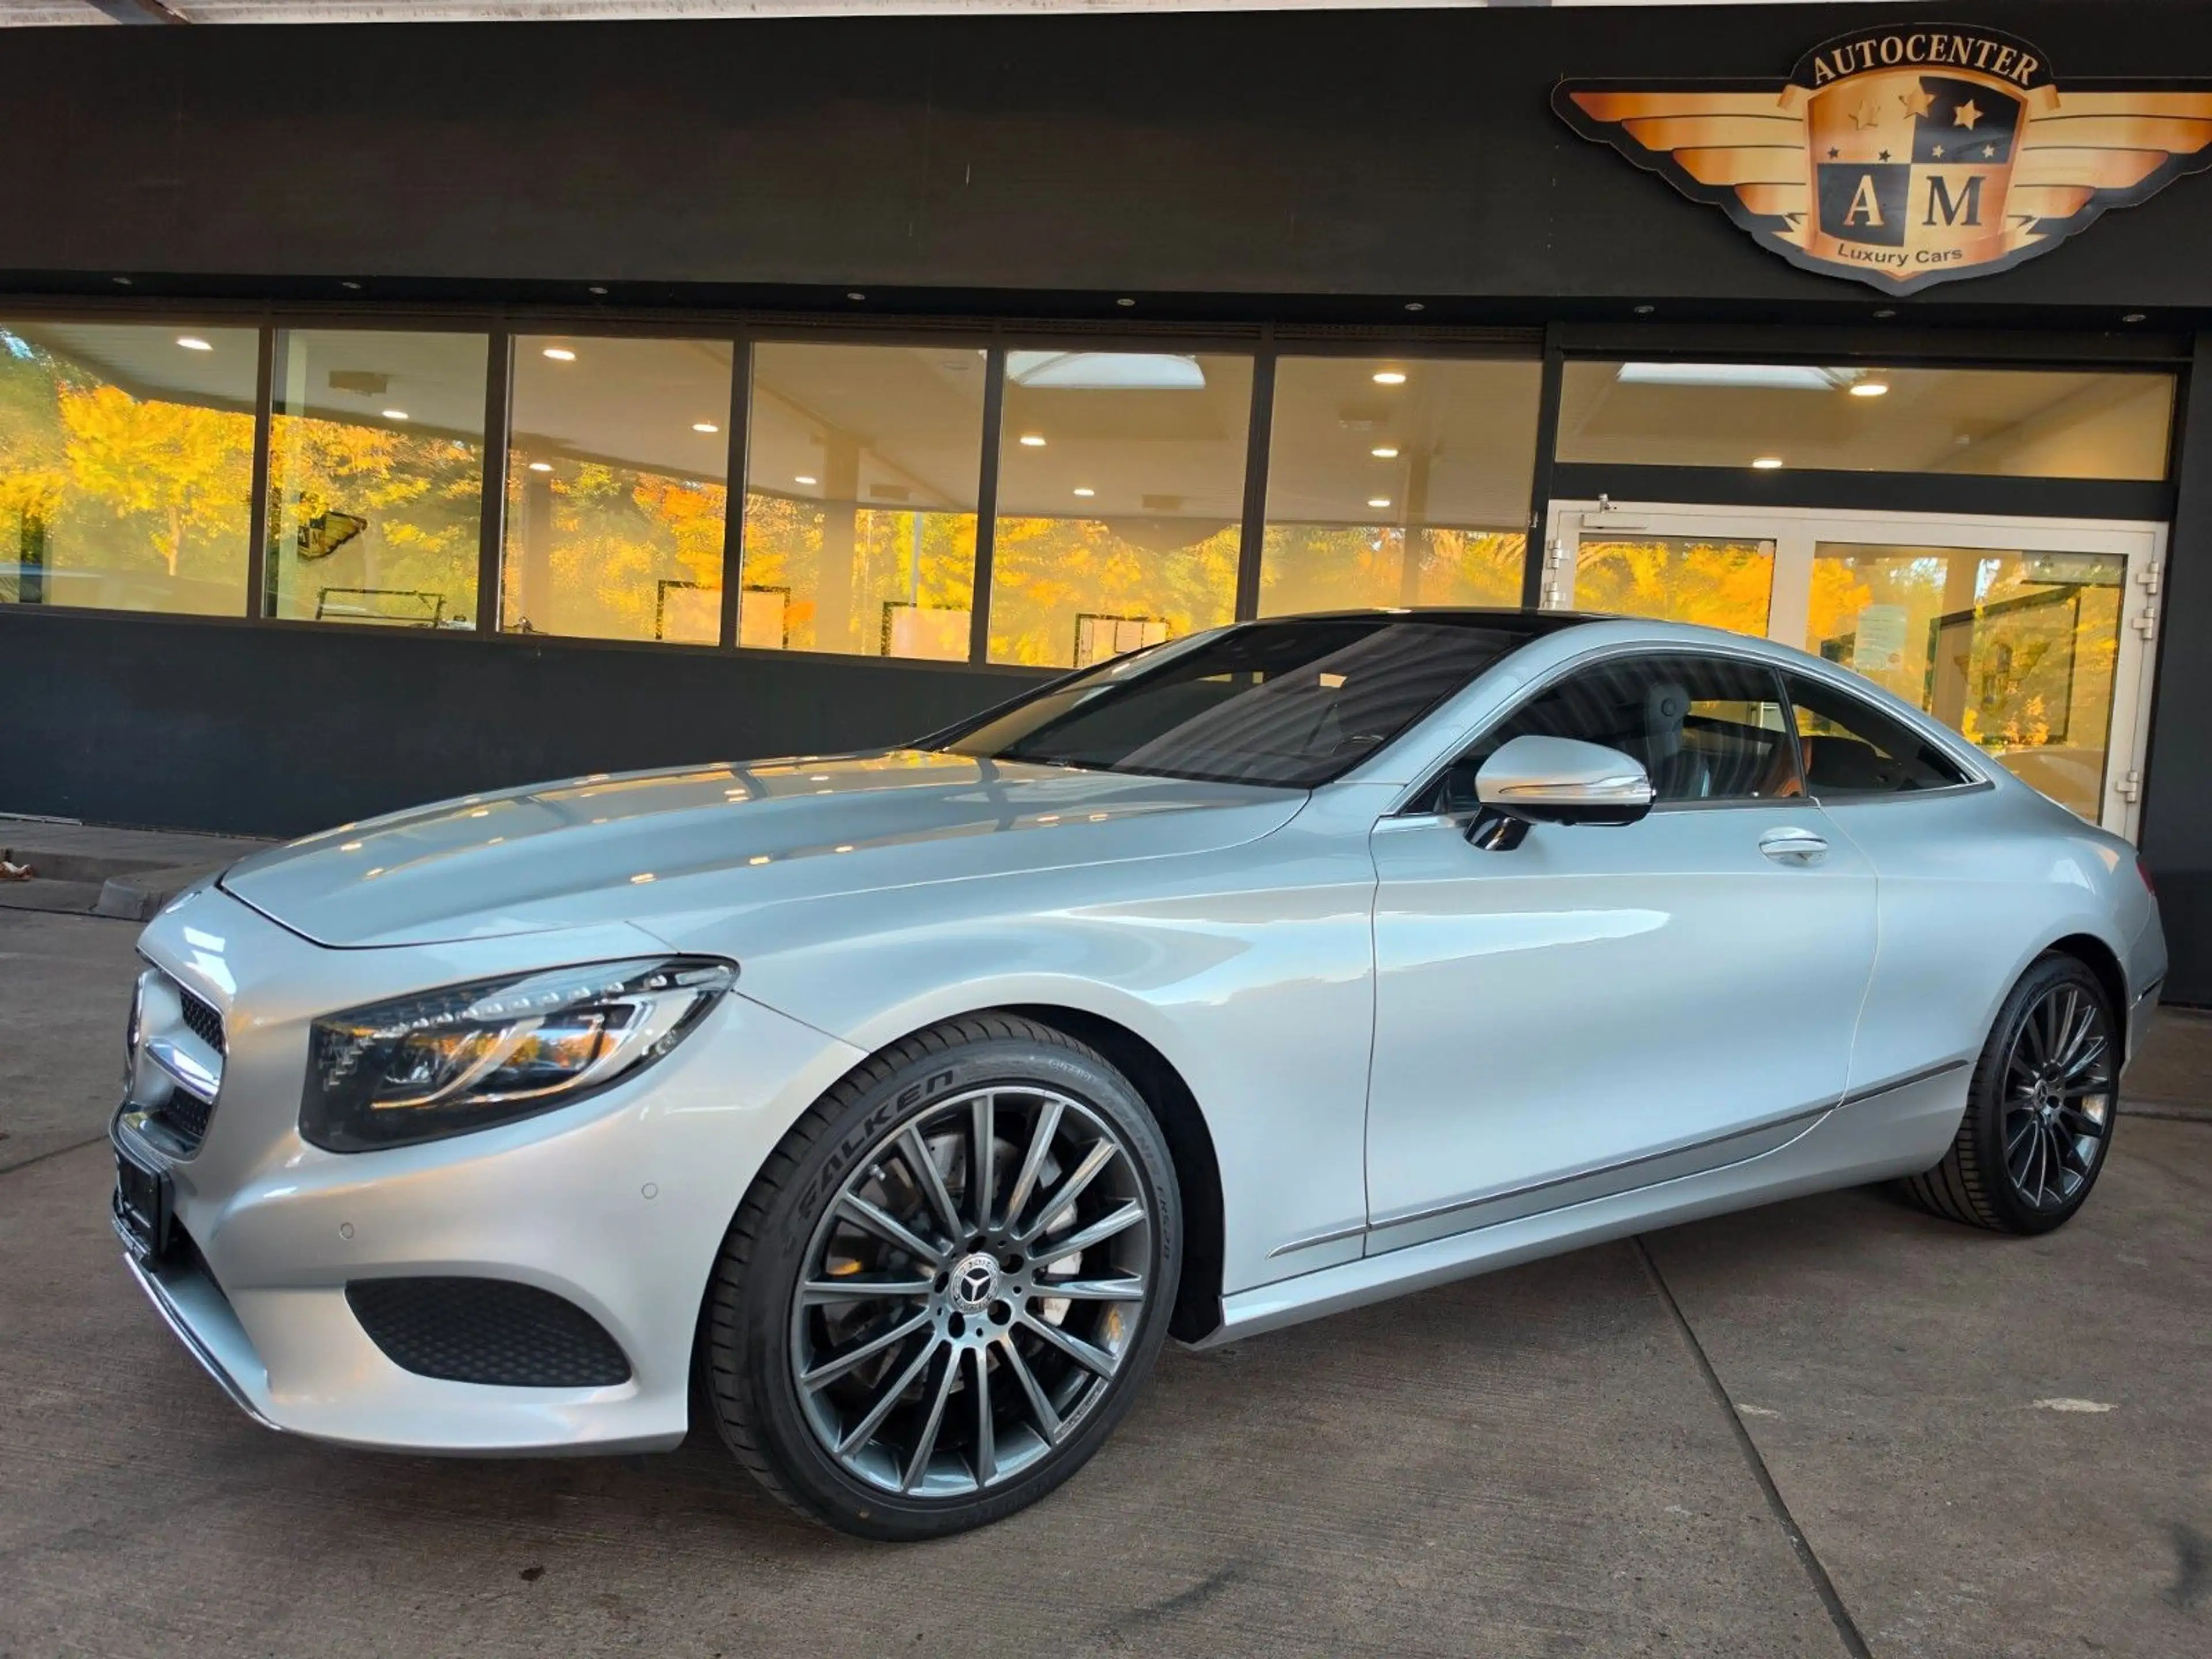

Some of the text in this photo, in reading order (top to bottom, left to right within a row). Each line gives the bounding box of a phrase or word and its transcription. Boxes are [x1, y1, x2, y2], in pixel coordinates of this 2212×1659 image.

[1813, 34, 2039, 86] AUTOCENTER
[1843, 174, 1986, 226] A M
[1837, 243, 1963, 267] Luxury Cars
[798, 1070, 954, 1221] FALKEN
